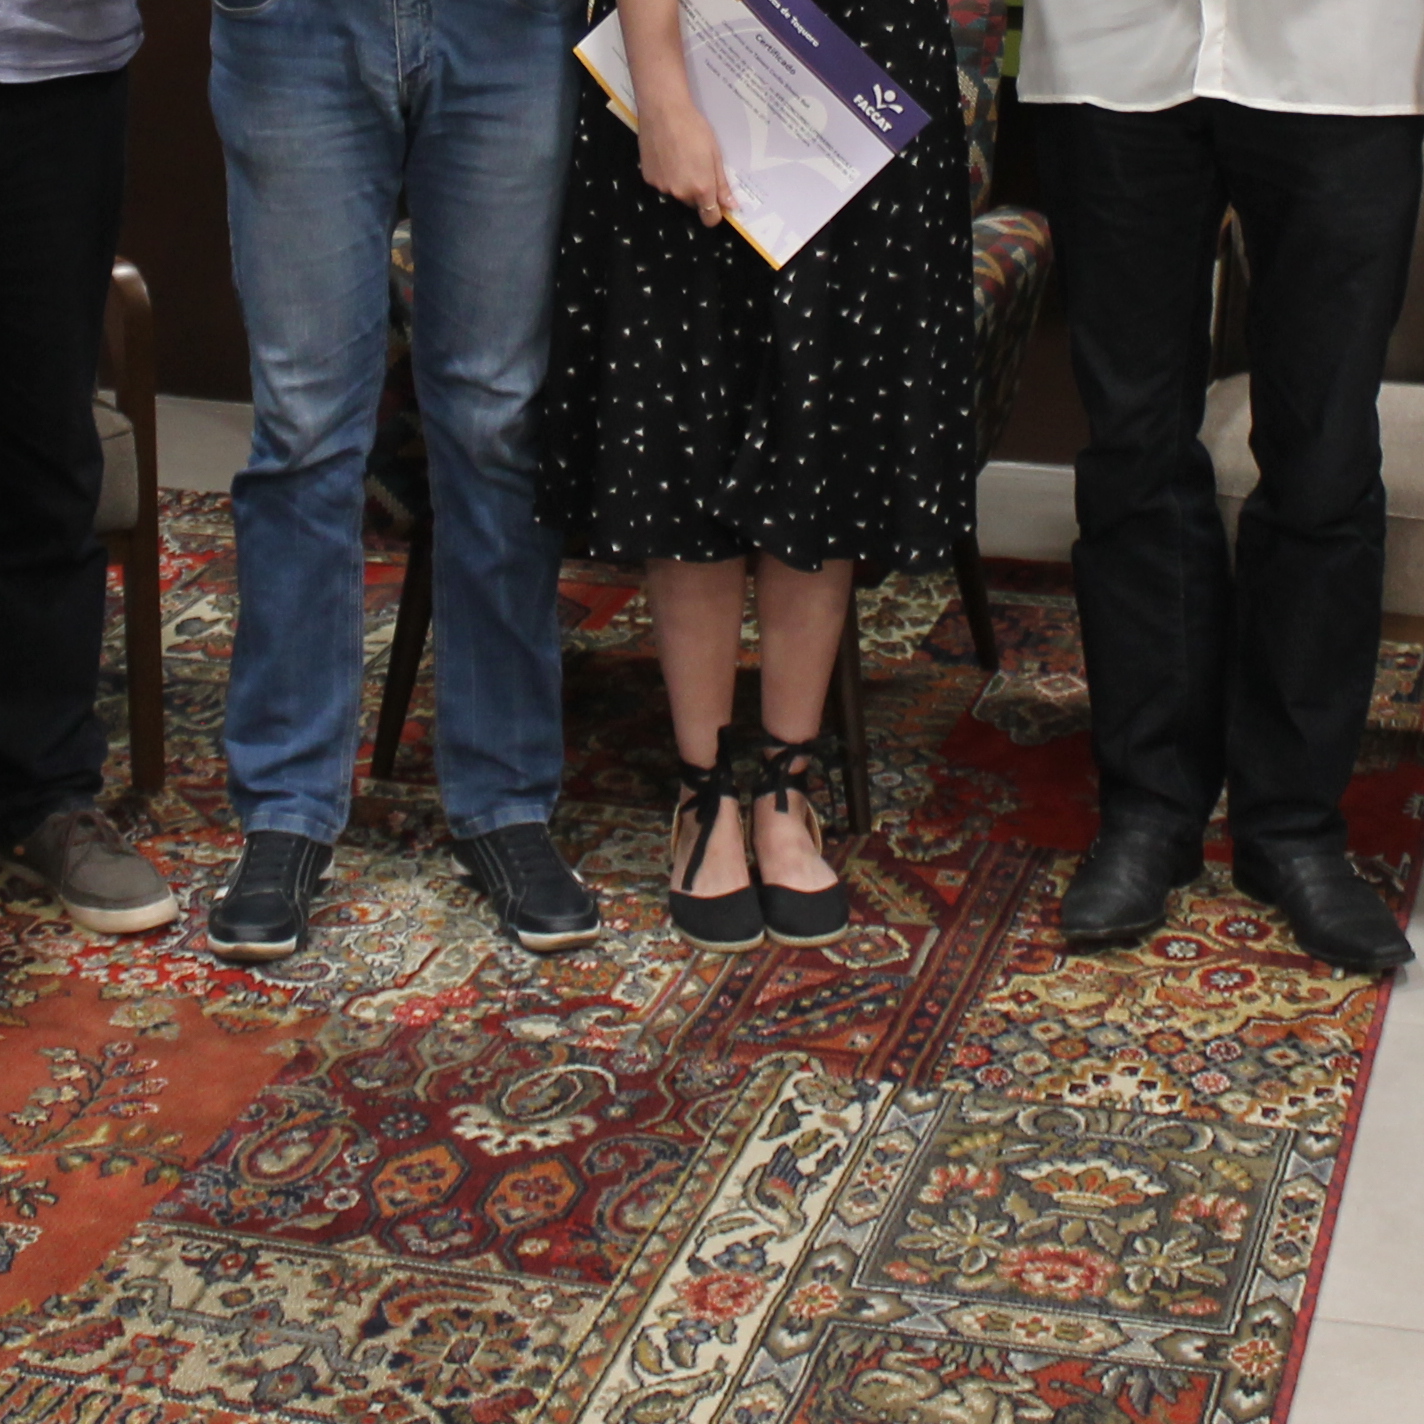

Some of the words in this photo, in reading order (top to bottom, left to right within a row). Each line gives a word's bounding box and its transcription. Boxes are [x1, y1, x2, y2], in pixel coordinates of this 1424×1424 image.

[779, 5, 792, 19] de
[788, 16, 820, 48] Taquara
[754, 32, 797, 76] Certificado
[852, 93, 892, 134] FACCAT
